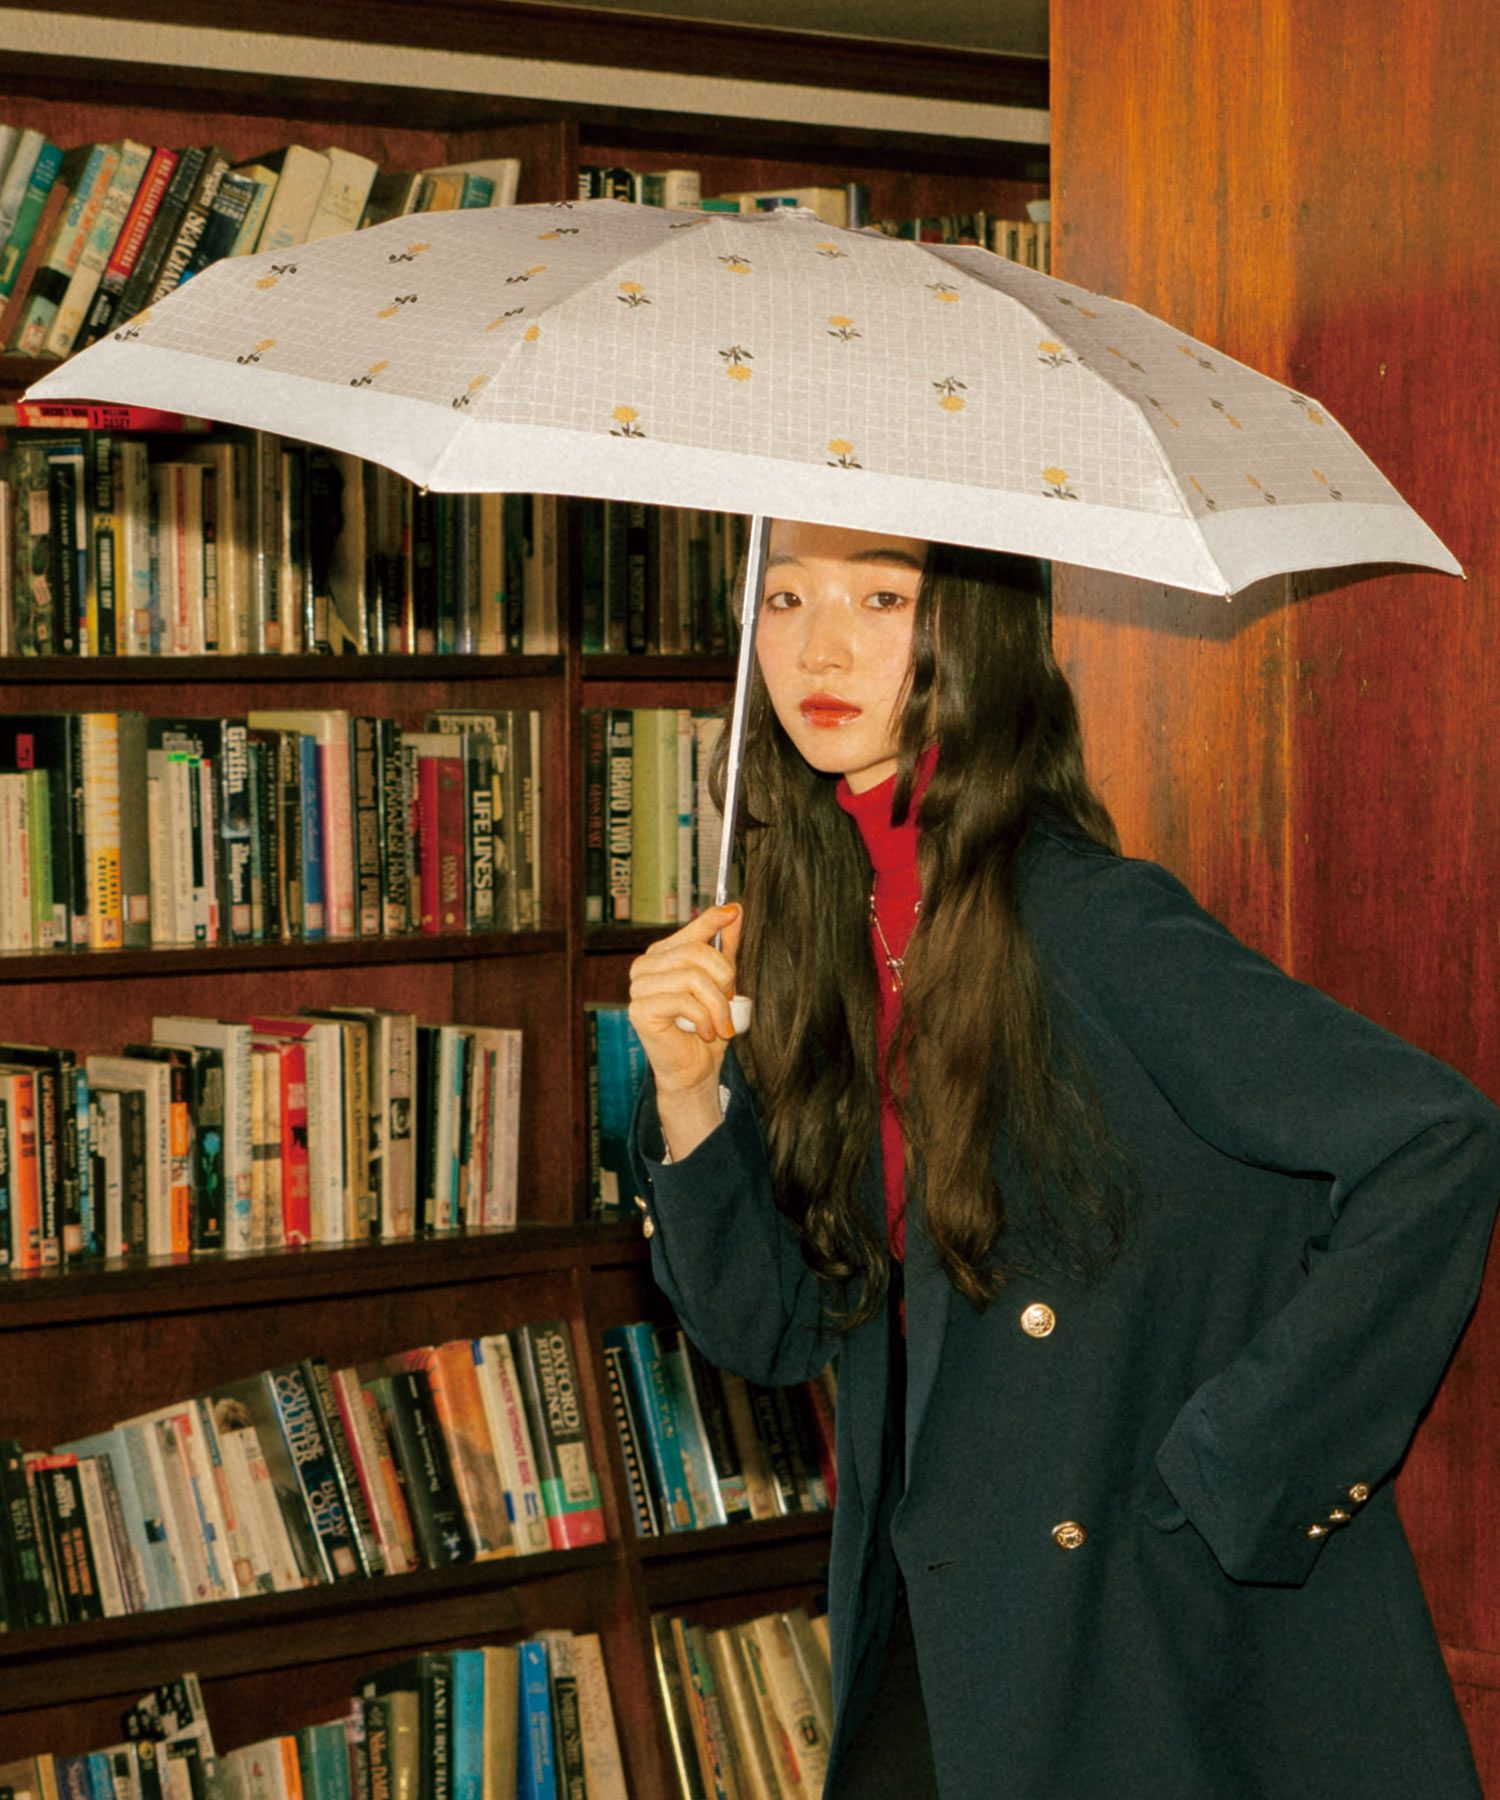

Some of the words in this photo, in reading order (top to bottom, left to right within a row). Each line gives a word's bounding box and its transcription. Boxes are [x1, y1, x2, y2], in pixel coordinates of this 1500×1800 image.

[177, 212, 206, 247] SEA
[610, 756, 632, 811] BRAVO
[472, 790, 491, 833] LIFE
[610, 815, 631, 853] TWO
[98, 856, 107, 915] CRICHTON
[109, 859, 117, 910] MICHAEL
[473, 836, 492, 889] LINES
[609, 856, 631, 896] ZERO
[537, 1338, 563, 1435] REFERENCE
[551, 1336, 580, 1427] OXFORD
[274, 1374, 312, 1466] COULTER
[290, 1369, 325, 1458] CATHERINE
[307, 1488, 334, 1538] OUT
[321, 1479, 348, 1538] BLOW
[434, 1676, 446, 1719] JANE
